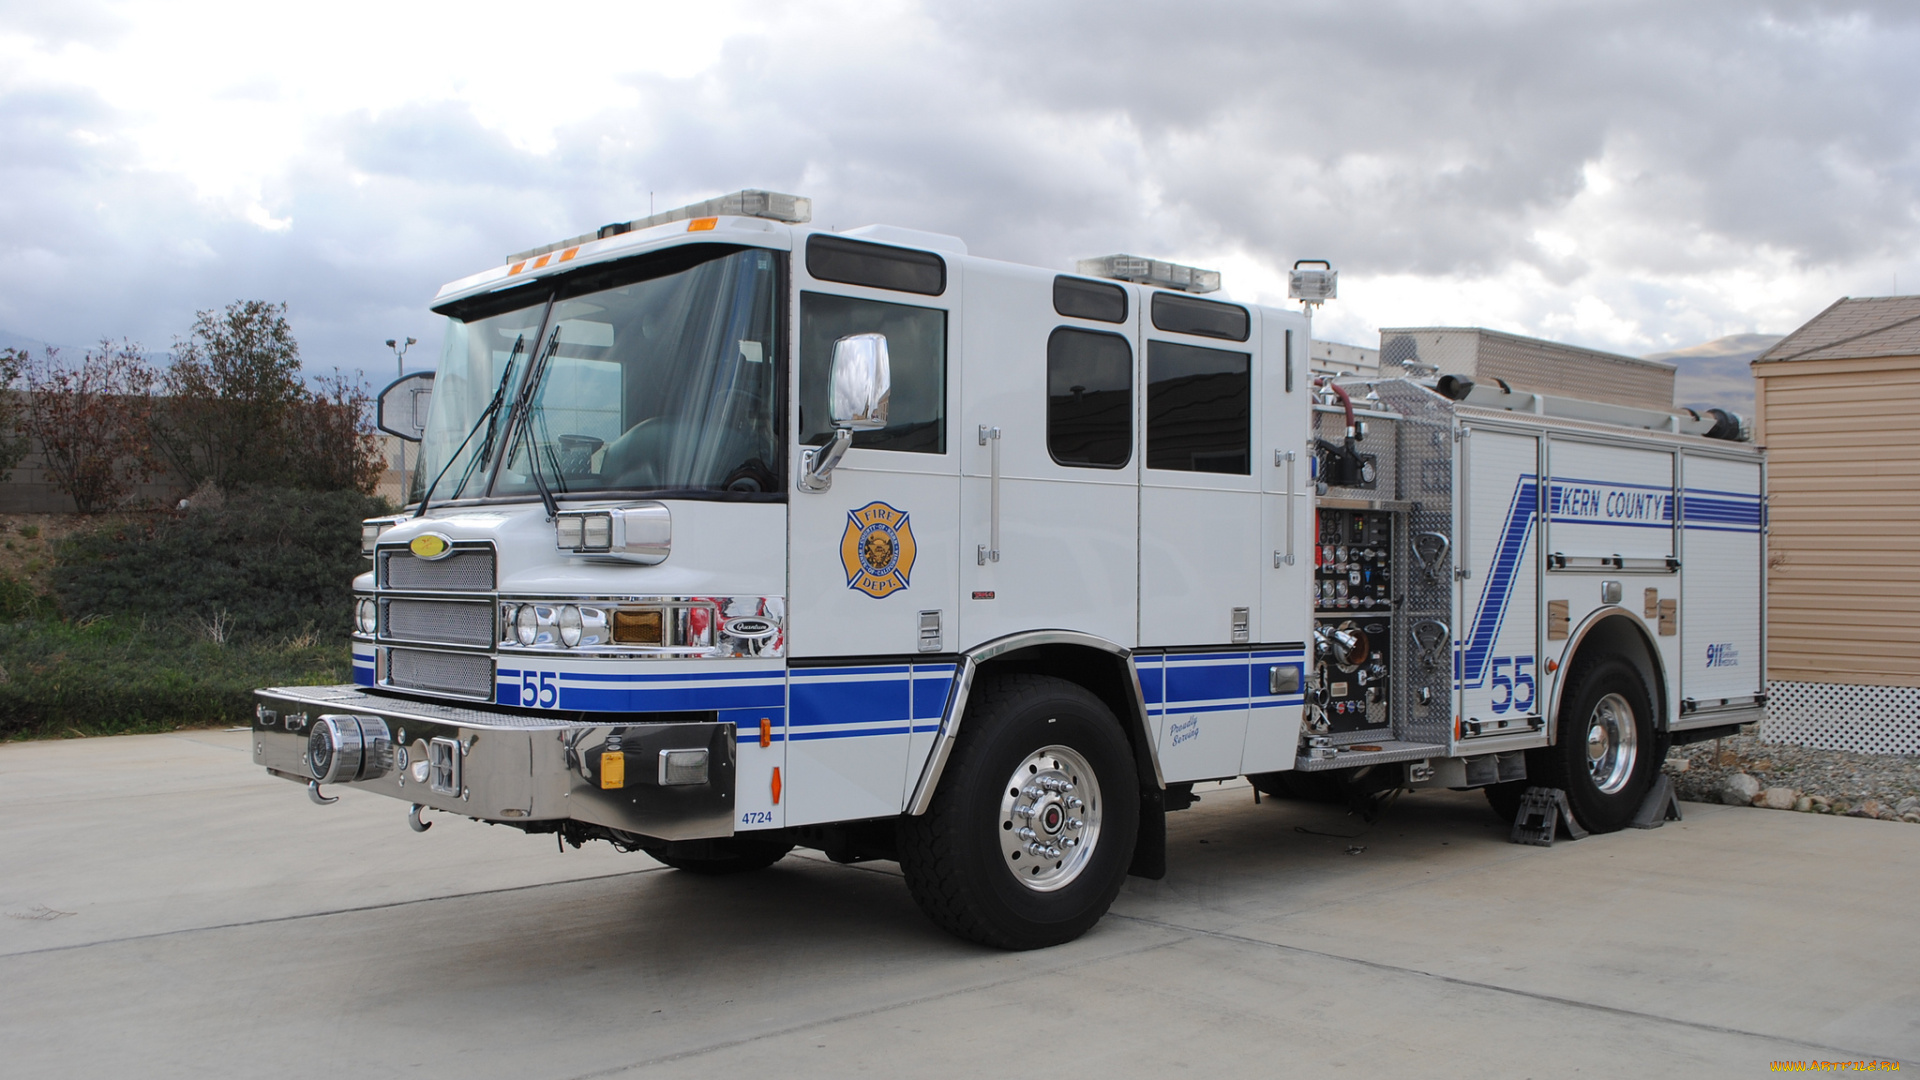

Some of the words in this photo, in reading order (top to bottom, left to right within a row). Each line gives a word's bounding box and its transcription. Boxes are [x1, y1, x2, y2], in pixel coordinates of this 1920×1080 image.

[1561, 487, 1601, 516] KERN
[1606, 491, 1664, 520] COUNTY
[864, 509, 895, 522] FIRE
[862, 577, 897, 591] DEPT.
[1706, 643, 1724, 668] 911
[522, 670, 558, 709] 55
[1491, 655, 1535, 714] 55
[1170, 714, 1198, 736] Proudly
[1172, 727, 1199, 747] Serving
[741, 811, 772, 825] 4724
